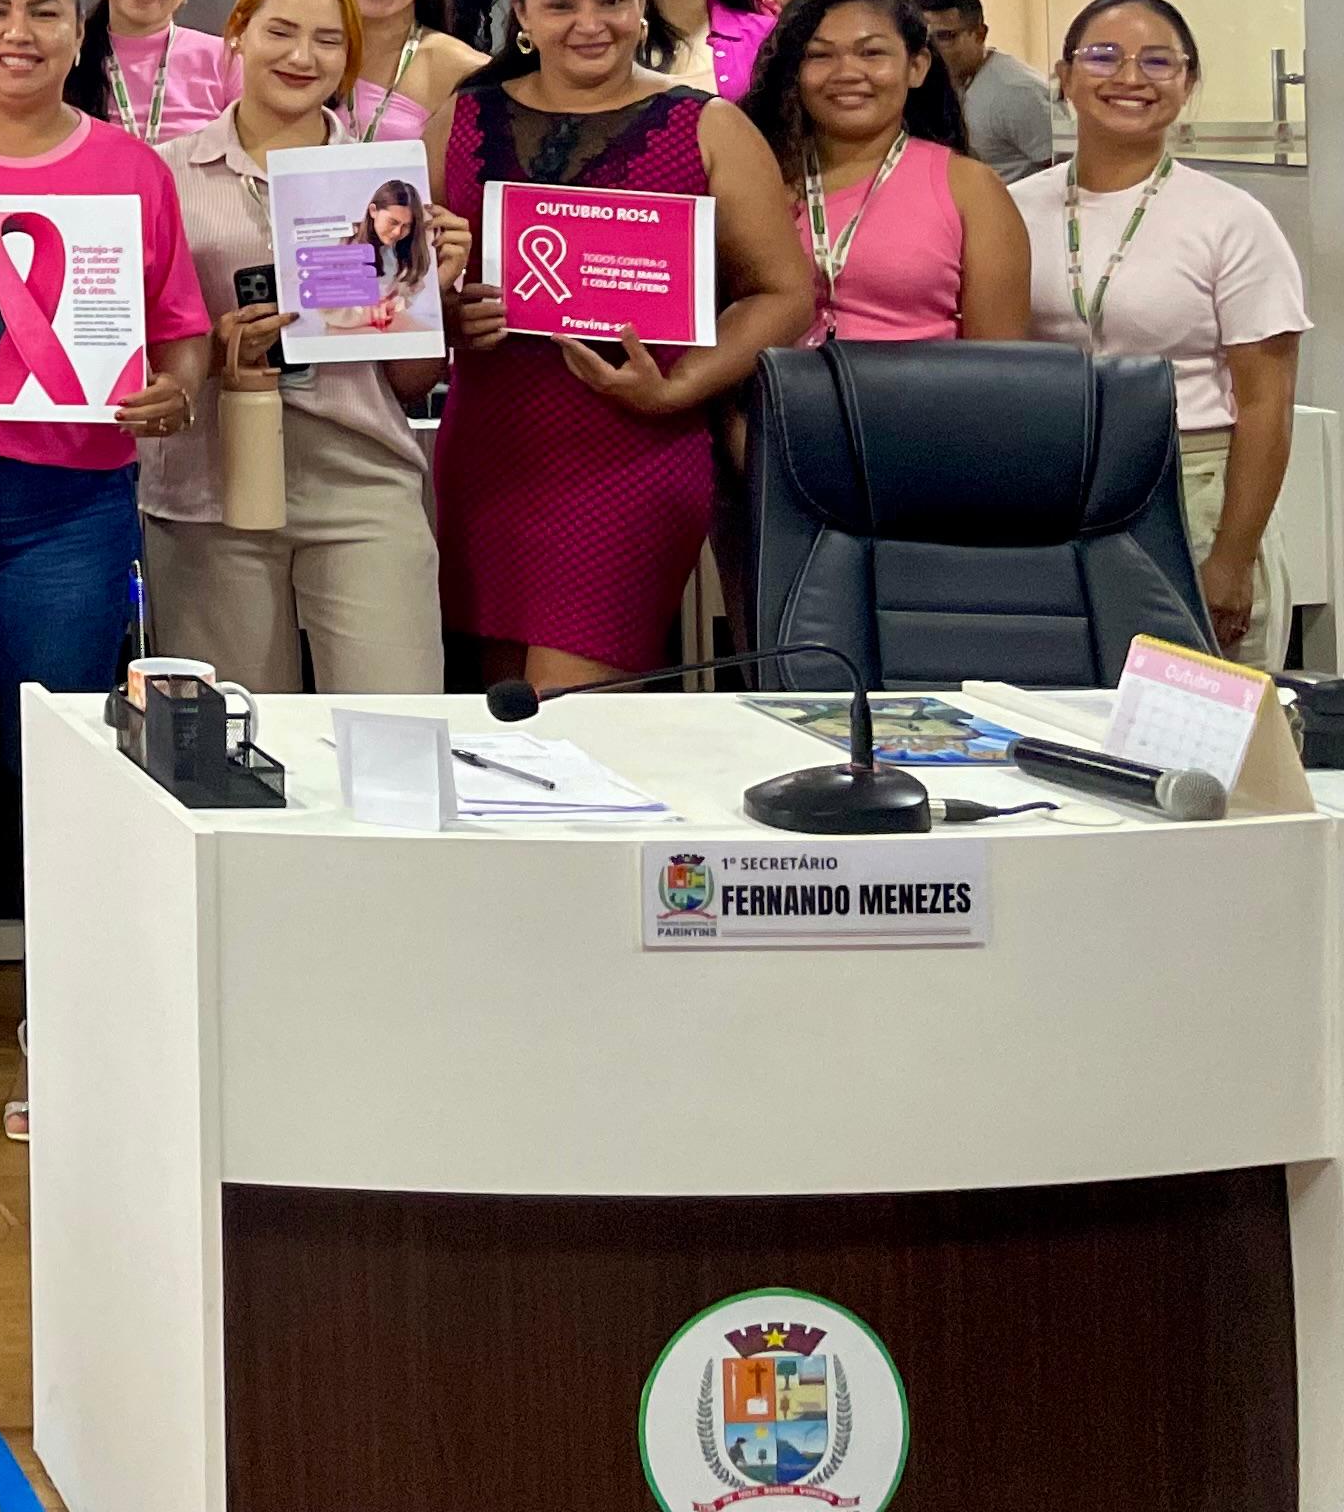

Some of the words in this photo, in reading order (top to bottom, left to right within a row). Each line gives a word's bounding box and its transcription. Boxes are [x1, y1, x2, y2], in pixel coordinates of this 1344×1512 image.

[536, 202, 614, 220] OUTUBRO
[616, 208, 660, 224] ROSA
[582, 253, 616, 265] TODOS
[657, 259, 668, 269] O
[580, 265, 620, 277] CÂNCER
[621, 269, 635, 278] DE
[590, 278, 618, 289] COLO
[1165, 664, 1220, 694] Outubro
[722, 857, 736, 870] 1º
[740, 854, 838, 870] SECRETÁRIO
[722, 885, 850, 916] FERNANDO
[859, 883, 972, 915] MENEZES
